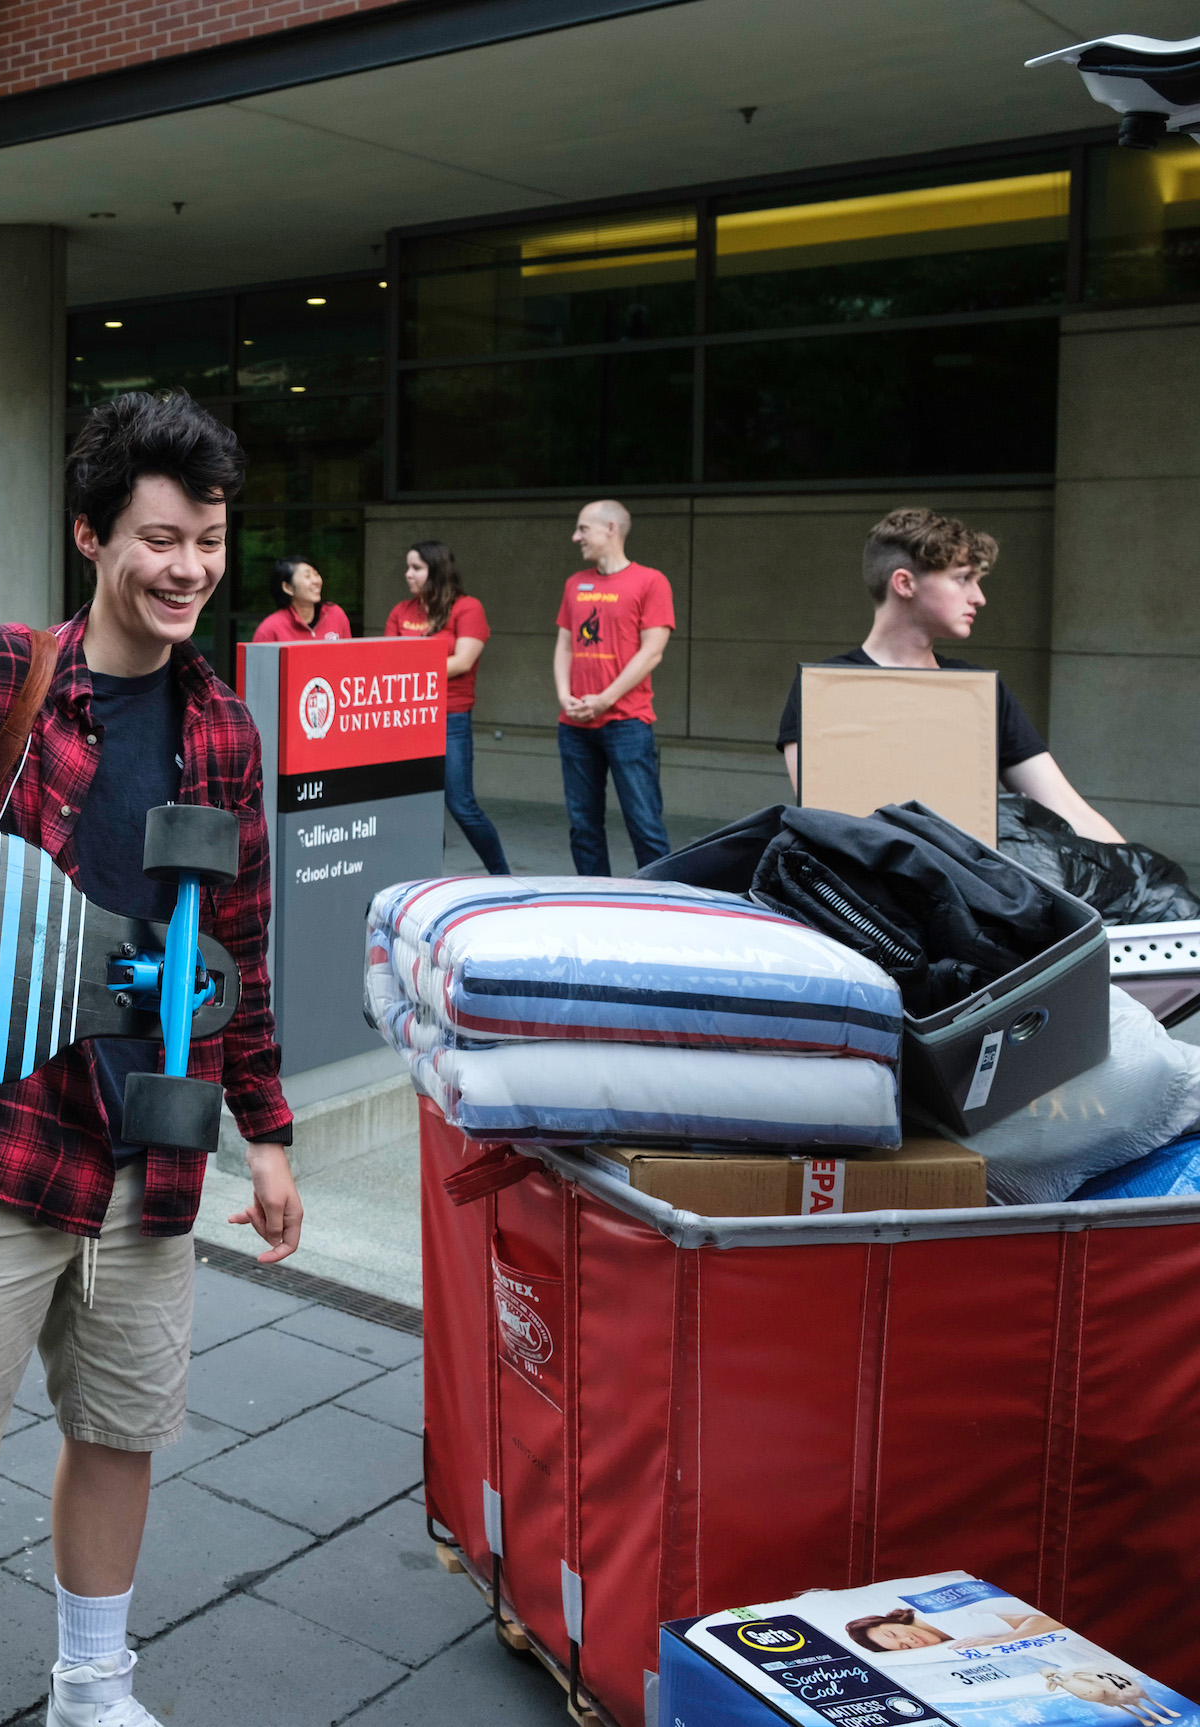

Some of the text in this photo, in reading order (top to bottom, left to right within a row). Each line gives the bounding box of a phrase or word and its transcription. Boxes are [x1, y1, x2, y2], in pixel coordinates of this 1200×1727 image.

[339, 671, 438, 708] SEATTLE
[340, 706, 438, 732] UNIVERSITY
[352, 816, 376, 839] Hall
[331, 861, 342, 877] of
[344, 861, 363, 875] Law
[930, 1588, 961, 1604] BEST
[746, 1629, 796, 1645] Serta
[782, 1666, 869, 1687] Soothing
[951, 1664, 992, 1685] 3 INCHES
[970, 1671, 1003, 1684] THICK
[800, 1680, 844, 1700] Cool
[821, 1700, 886, 1720] MATTRESS
[836, 1713, 889, 1727] TOPPER
